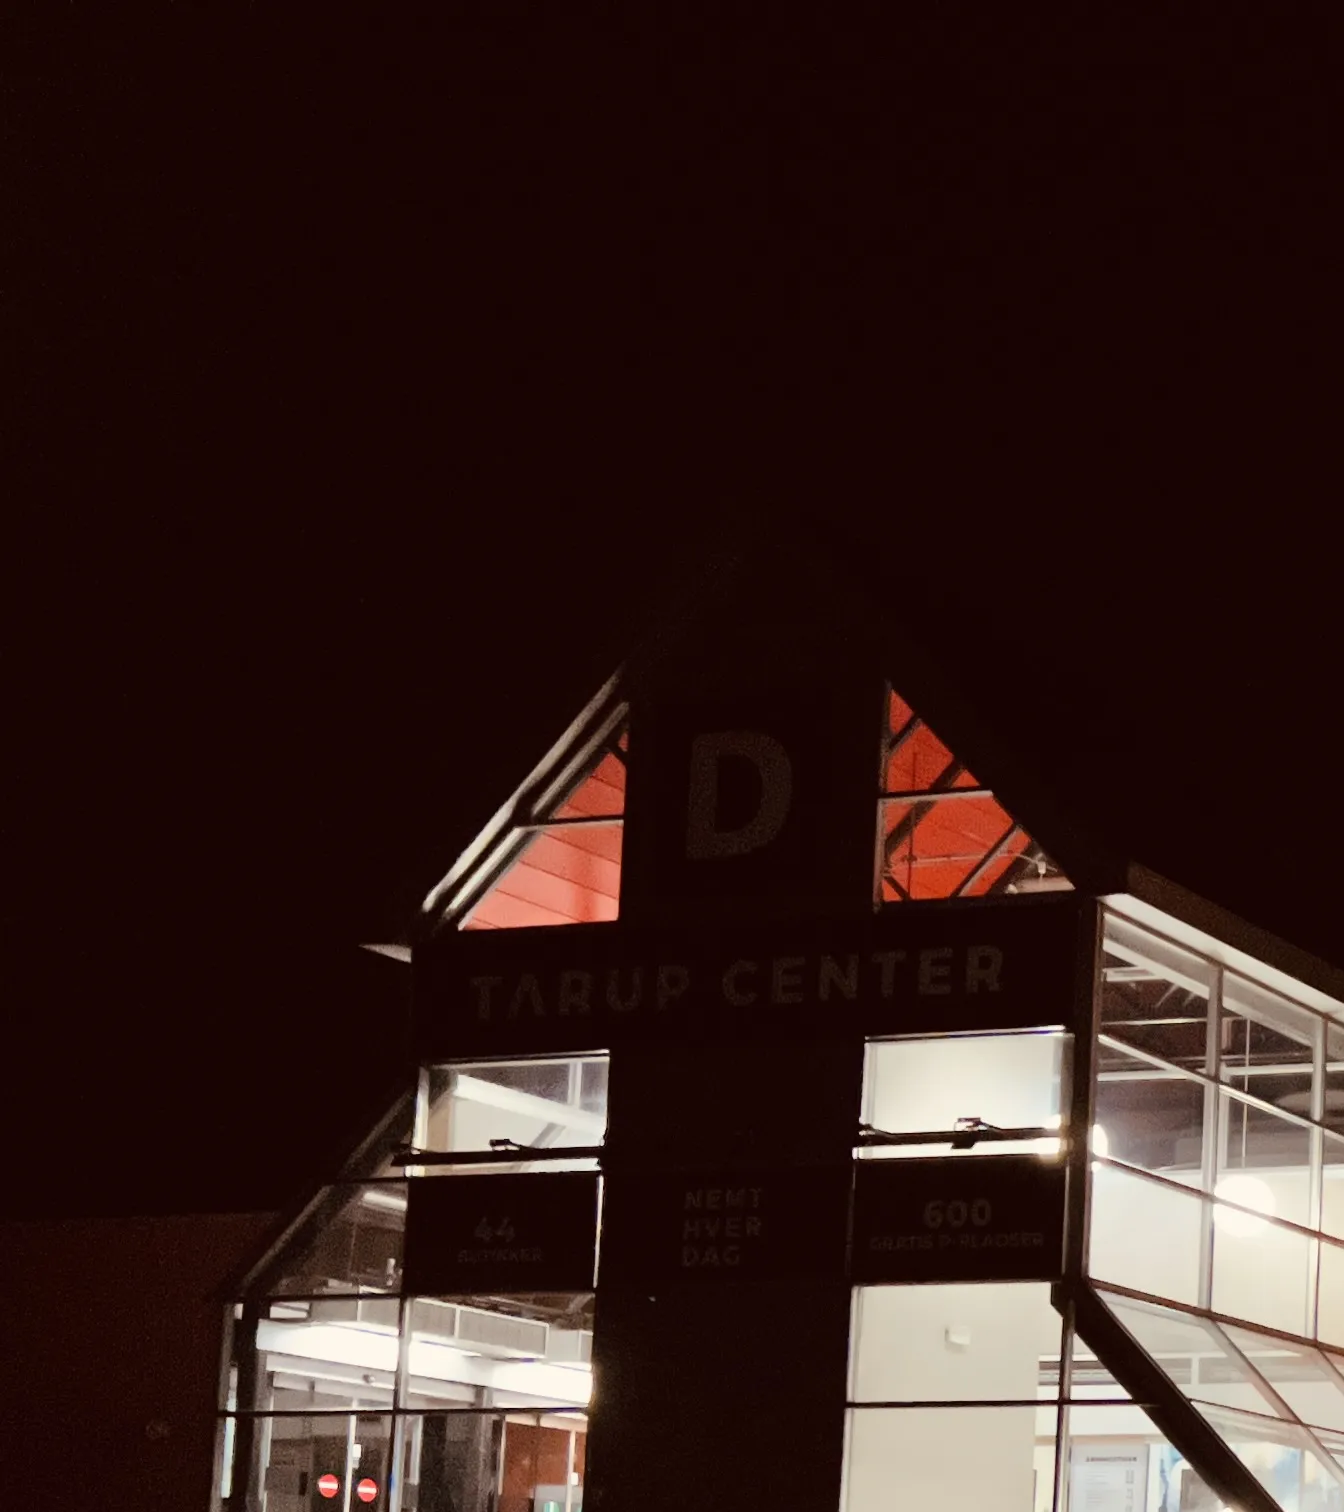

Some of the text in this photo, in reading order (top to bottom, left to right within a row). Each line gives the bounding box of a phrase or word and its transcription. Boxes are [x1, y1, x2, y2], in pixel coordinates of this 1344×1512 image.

[686, 730, 793, 861] D
[469, 944, 1003, 1023] TARUP CENTER
[683, 1187, 763, 1210] NEMT
[923, 1197, 992, 1229] 600
[473, 1216, 516, 1243] 44
[682, 1215, 762, 1241] HVER
[681, 1244, 740, 1267] DAG
